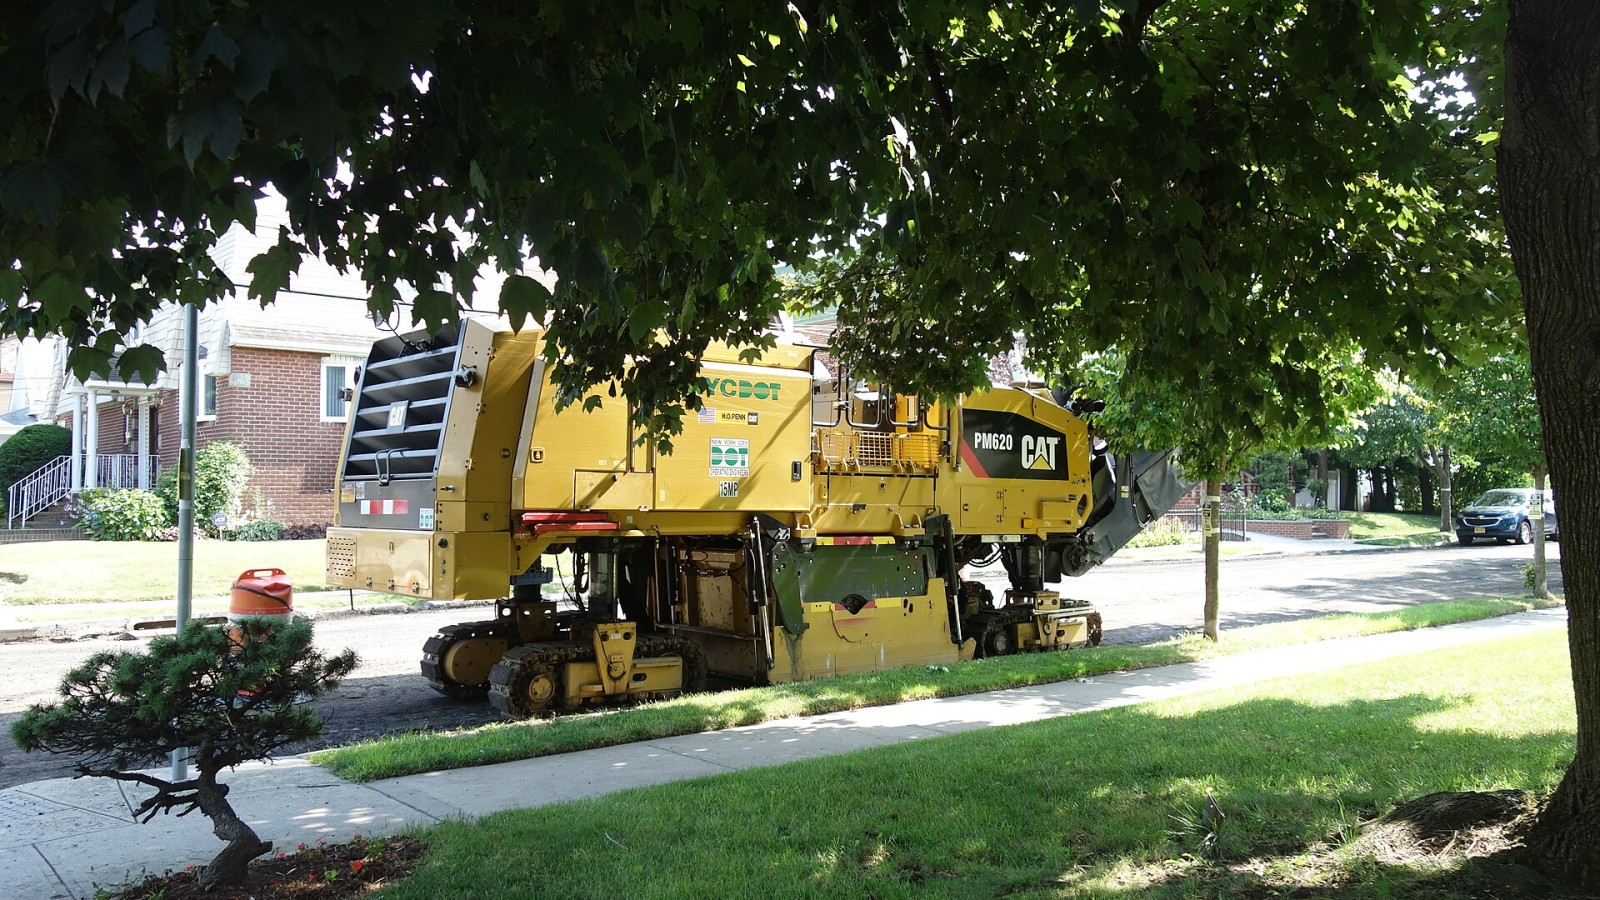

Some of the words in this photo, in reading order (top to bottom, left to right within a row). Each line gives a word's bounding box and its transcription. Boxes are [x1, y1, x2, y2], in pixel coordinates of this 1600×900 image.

[688, 377, 781, 400] YCDOT
[974, 431, 1013, 451] PM620
[711, 446, 748, 467] DOT
[1021, 434, 1059, 471] CAT
[720, 481, 739, 497] 15MP
